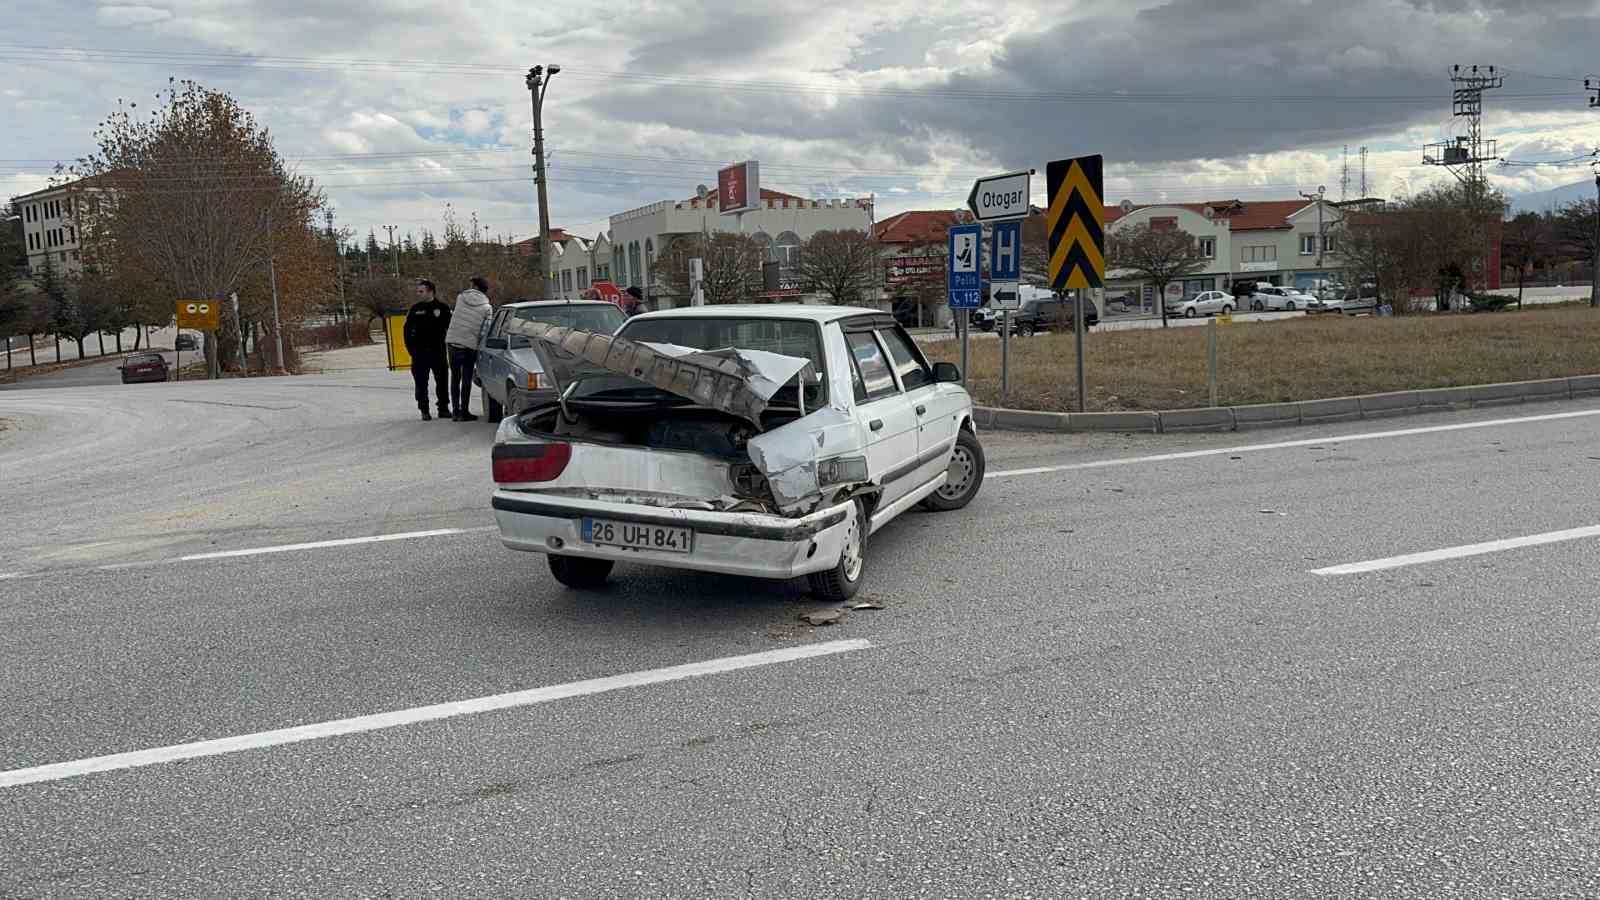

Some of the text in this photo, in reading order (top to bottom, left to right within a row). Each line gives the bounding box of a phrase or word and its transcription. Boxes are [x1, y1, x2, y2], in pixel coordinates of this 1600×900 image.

[983, 191, 1023, 209] Otogar
[996, 229, 1015, 272] H
[964, 291, 979, 303] 112
[593, 522, 688, 549] 26 UH 841
